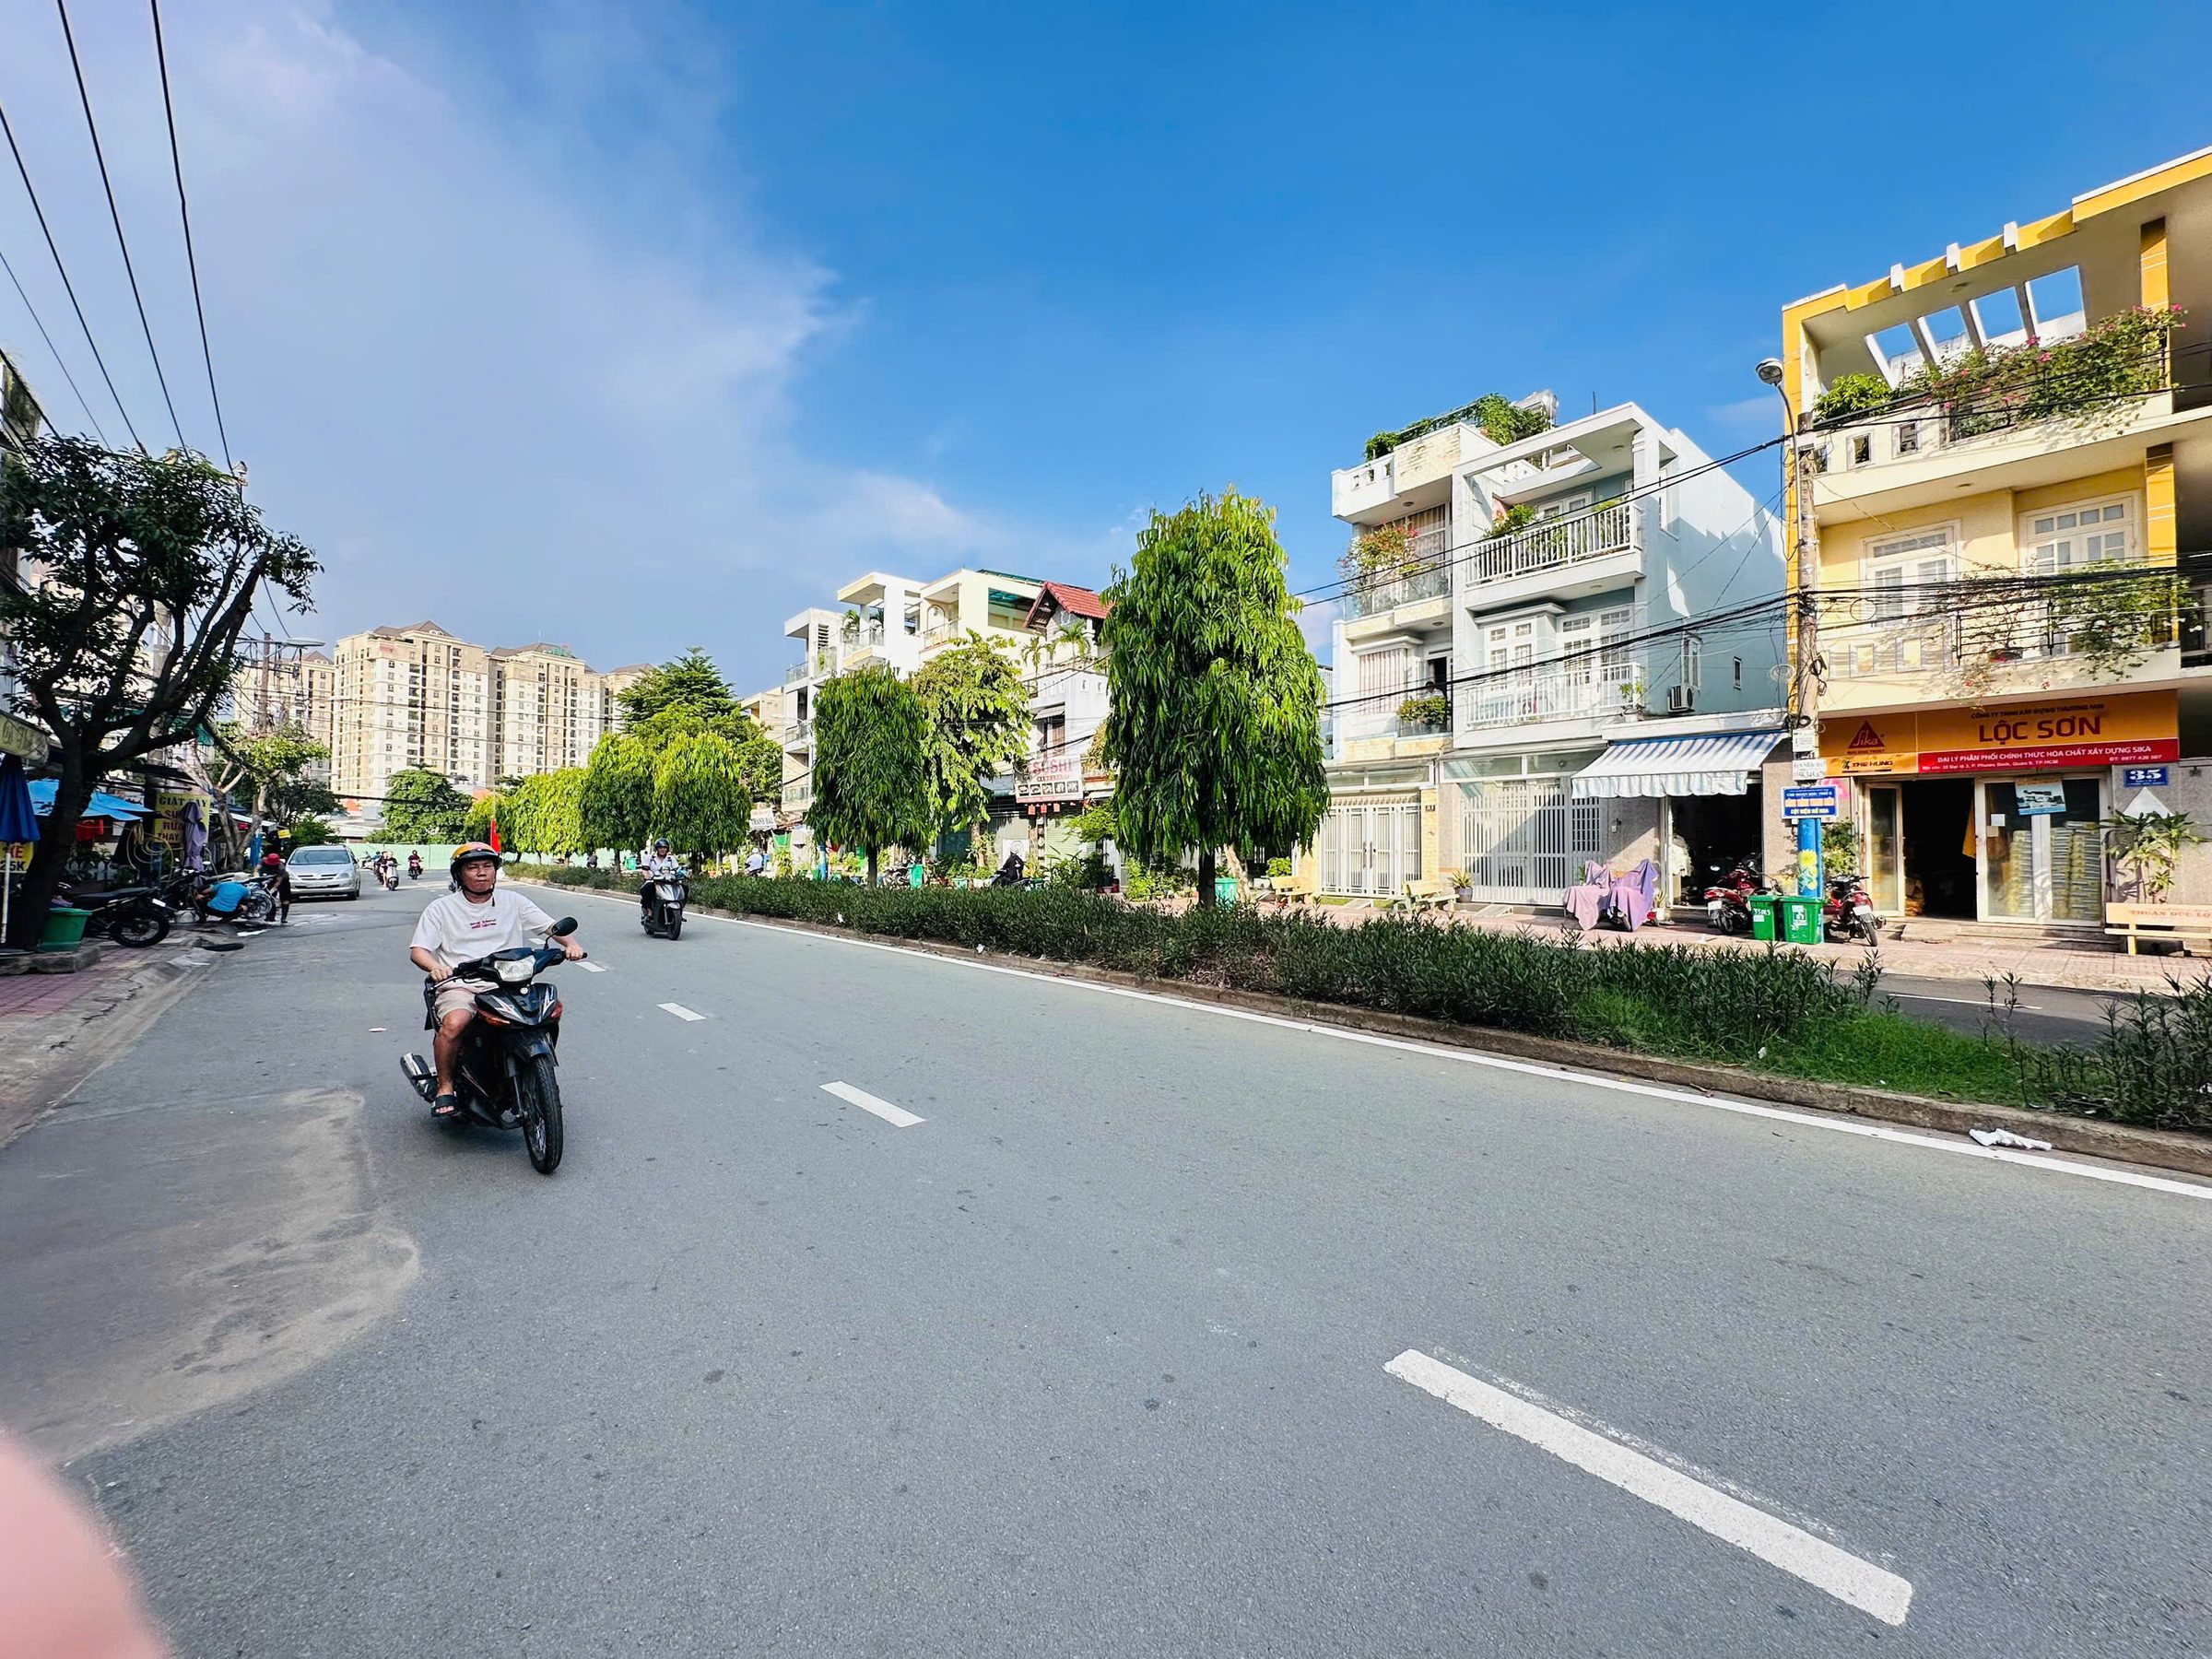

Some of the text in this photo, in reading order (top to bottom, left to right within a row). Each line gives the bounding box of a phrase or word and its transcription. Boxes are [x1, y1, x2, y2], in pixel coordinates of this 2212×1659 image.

[1979, 715, 2100, 745] LỘC SƠN
[1852, 730, 1878, 747] Sika
[1959, 753, 1980, 761] PHÂN
[1981, 752, 1998, 761] PHỐI
[1999, 752, 2023, 760] CHÍNH
[2065, 747, 2087, 757] CHẤT
[2088, 747, 2104, 756] XÂY
[2105, 747, 2132, 757] DỰNG
[2132, 746, 2151, 754] SIKA
[2129, 769, 2162, 781] 35
